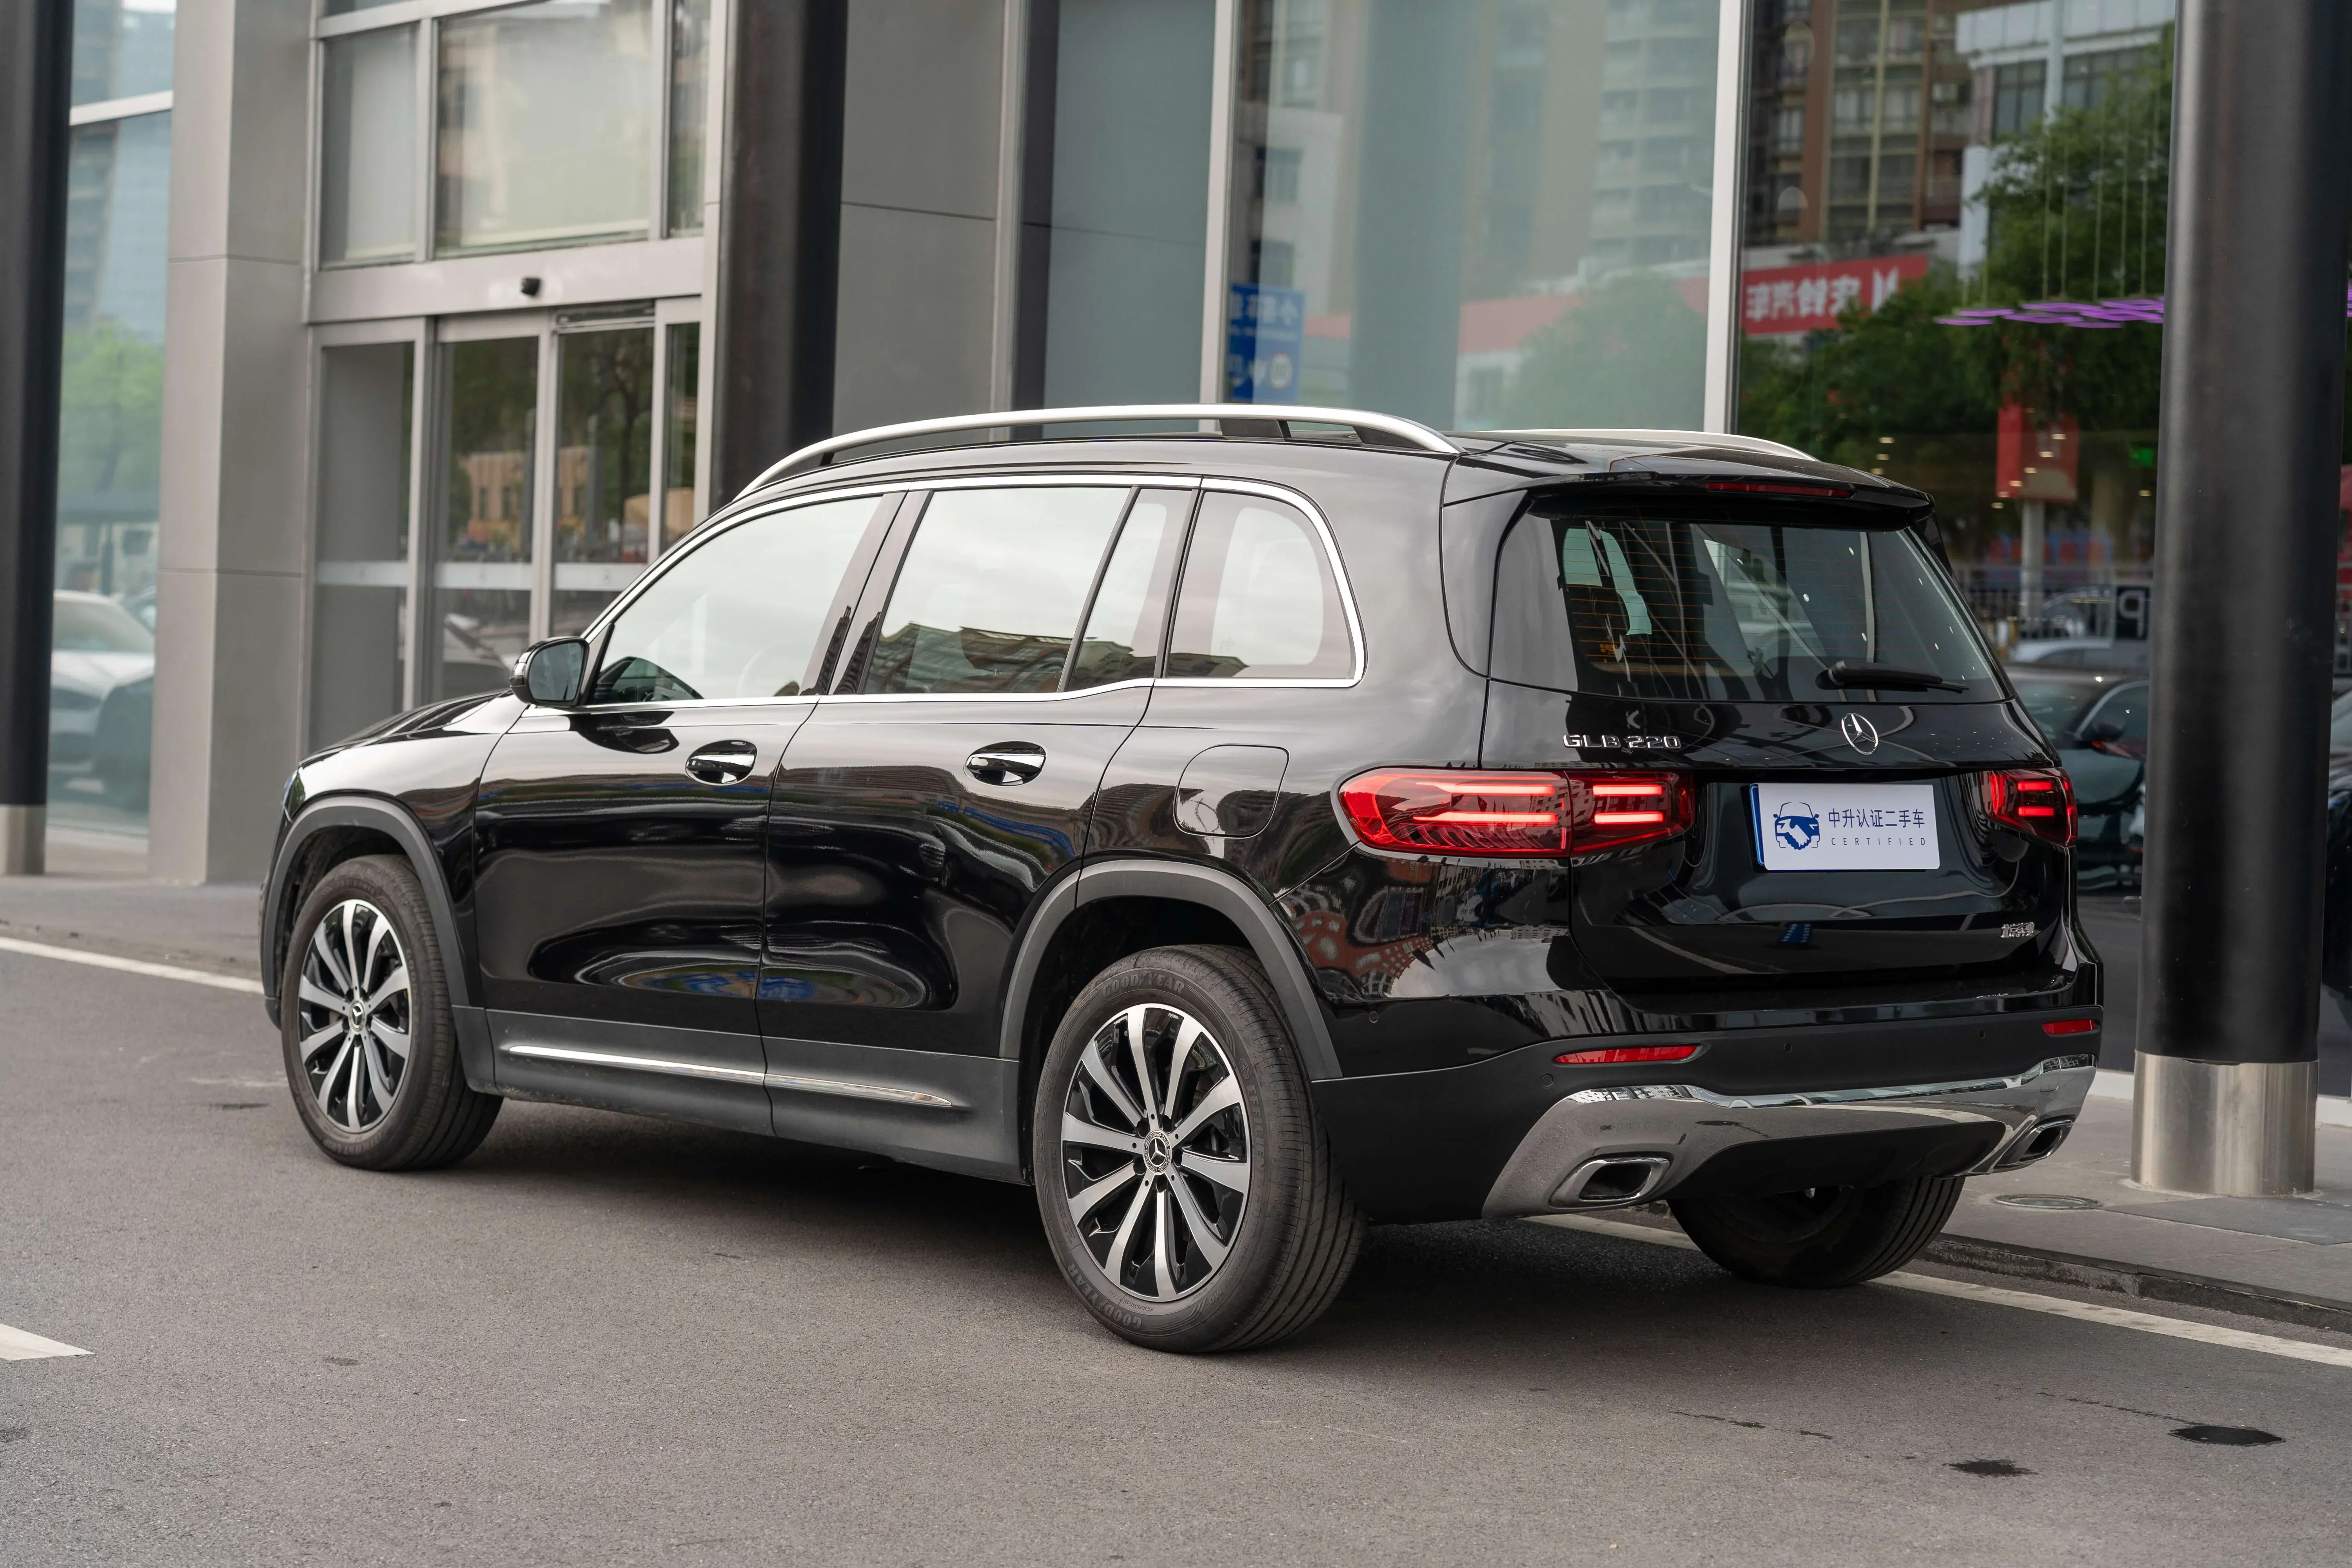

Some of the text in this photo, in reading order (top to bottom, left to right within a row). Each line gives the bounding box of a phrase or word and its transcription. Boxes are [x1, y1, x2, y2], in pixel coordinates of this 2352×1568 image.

[1563, 734, 1681, 749] GLB 220
[1828, 808, 1925, 828] 中升认证二手车
[1831, 837, 1926, 846] CERTIFIED
[2000, 922, 2035, 938] 北京奔驰
